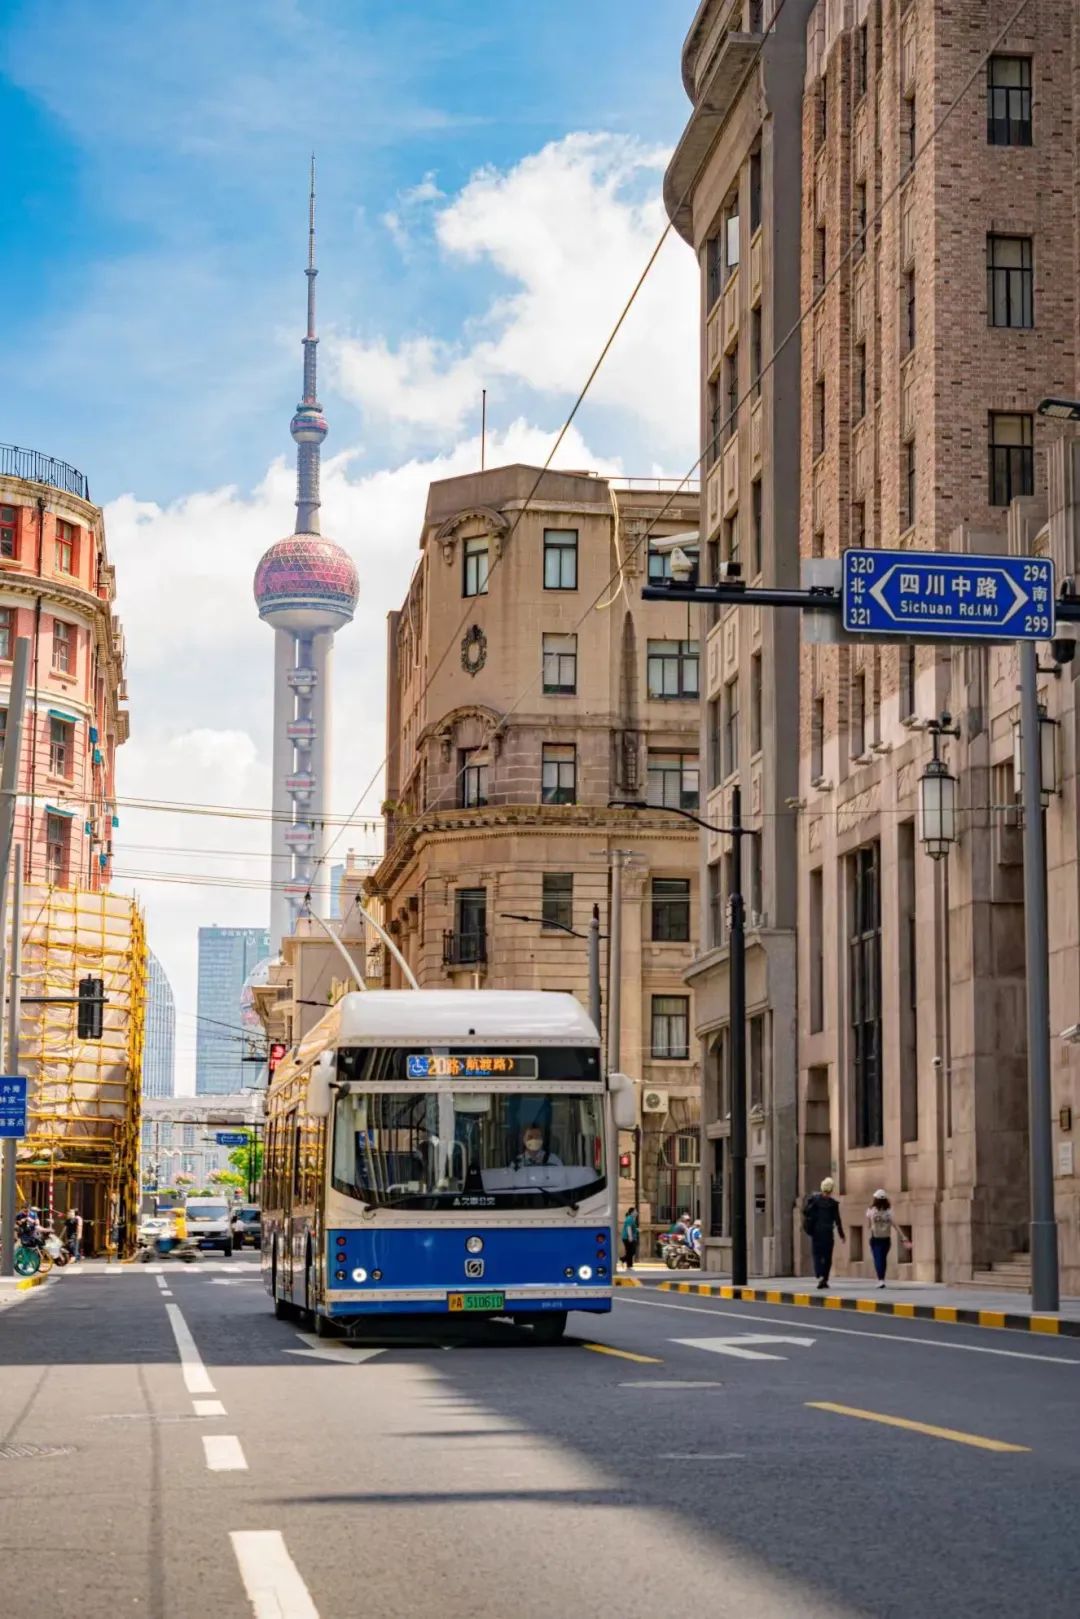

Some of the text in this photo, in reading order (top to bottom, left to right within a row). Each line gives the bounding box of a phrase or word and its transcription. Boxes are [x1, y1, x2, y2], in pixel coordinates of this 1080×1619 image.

[850, 556, 875, 574] 320
[1023, 565, 1048, 582] 294
[850, 577, 866, 593] 北
[900, 574, 998, 599] 四川中路
[853, 596, 862, 604] N
[1032, 586, 1048, 602] 南
[850, 608, 871, 625] 321
[900, 600, 998, 617] Sichuan Rd.(M)
[1036, 604, 1044, 613] S
[1024, 616, 1049, 632] 299
